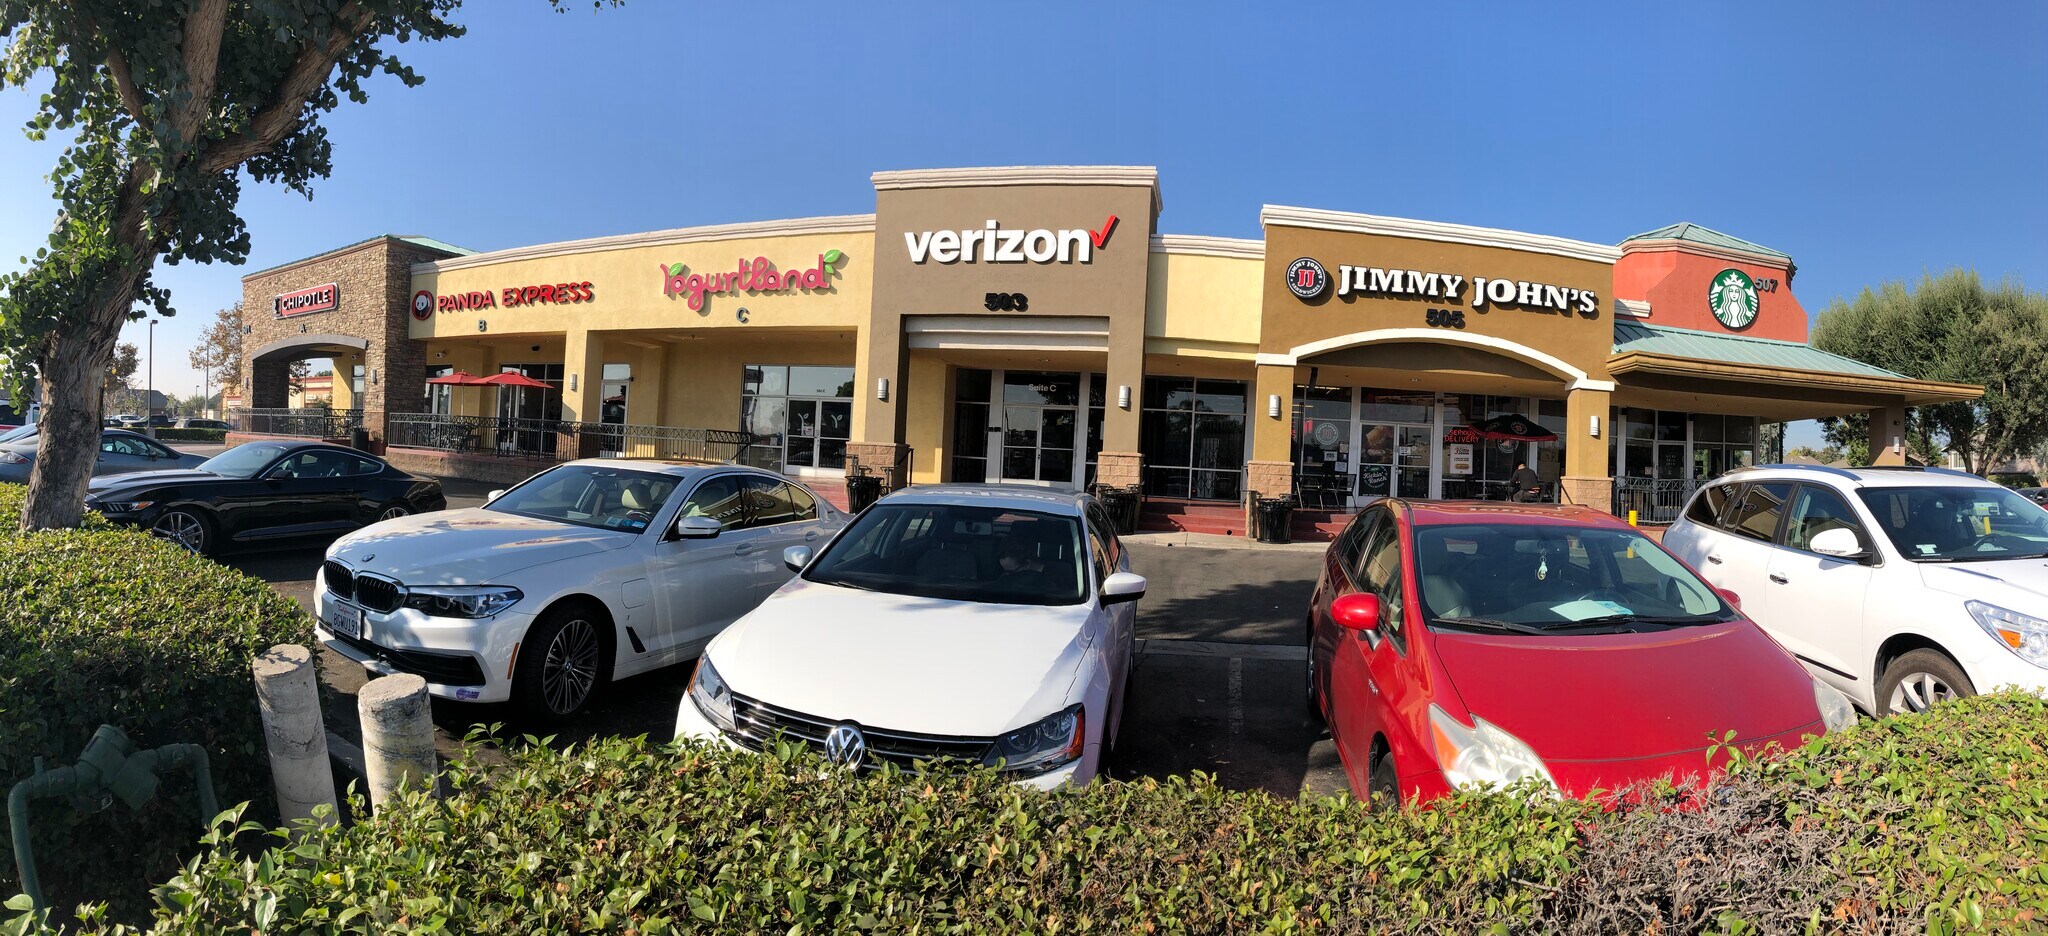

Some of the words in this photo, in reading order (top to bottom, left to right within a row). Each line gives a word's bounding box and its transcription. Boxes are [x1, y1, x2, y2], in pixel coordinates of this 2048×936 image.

[904, 219, 1091, 263] verizon
[1290, 261, 1306, 277] JIMMY
[1298, 269, 1315, 287] JJ
[660, 253, 830, 312] Yogurtland
[1338, 265, 1463, 298] JIMMY
[1471, 276, 1596, 313] JOHN'S
[1755, 278, 1778, 293] 507
[281, 289, 330, 310] CHIPOTLE
[437, 290, 495, 312] PANDA
[502, 281, 593, 306] EXPRESS
[984, 292, 1029, 312] 503
[736, 307, 749, 322] C
[1426, 308, 1465, 327] 505
[478, 320, 486, 331] B
[1028, 383, 1048, 392] Suite
[1049, 384, 1057, 392] C
[1444, 435, 1480, 443] DELIVERY
